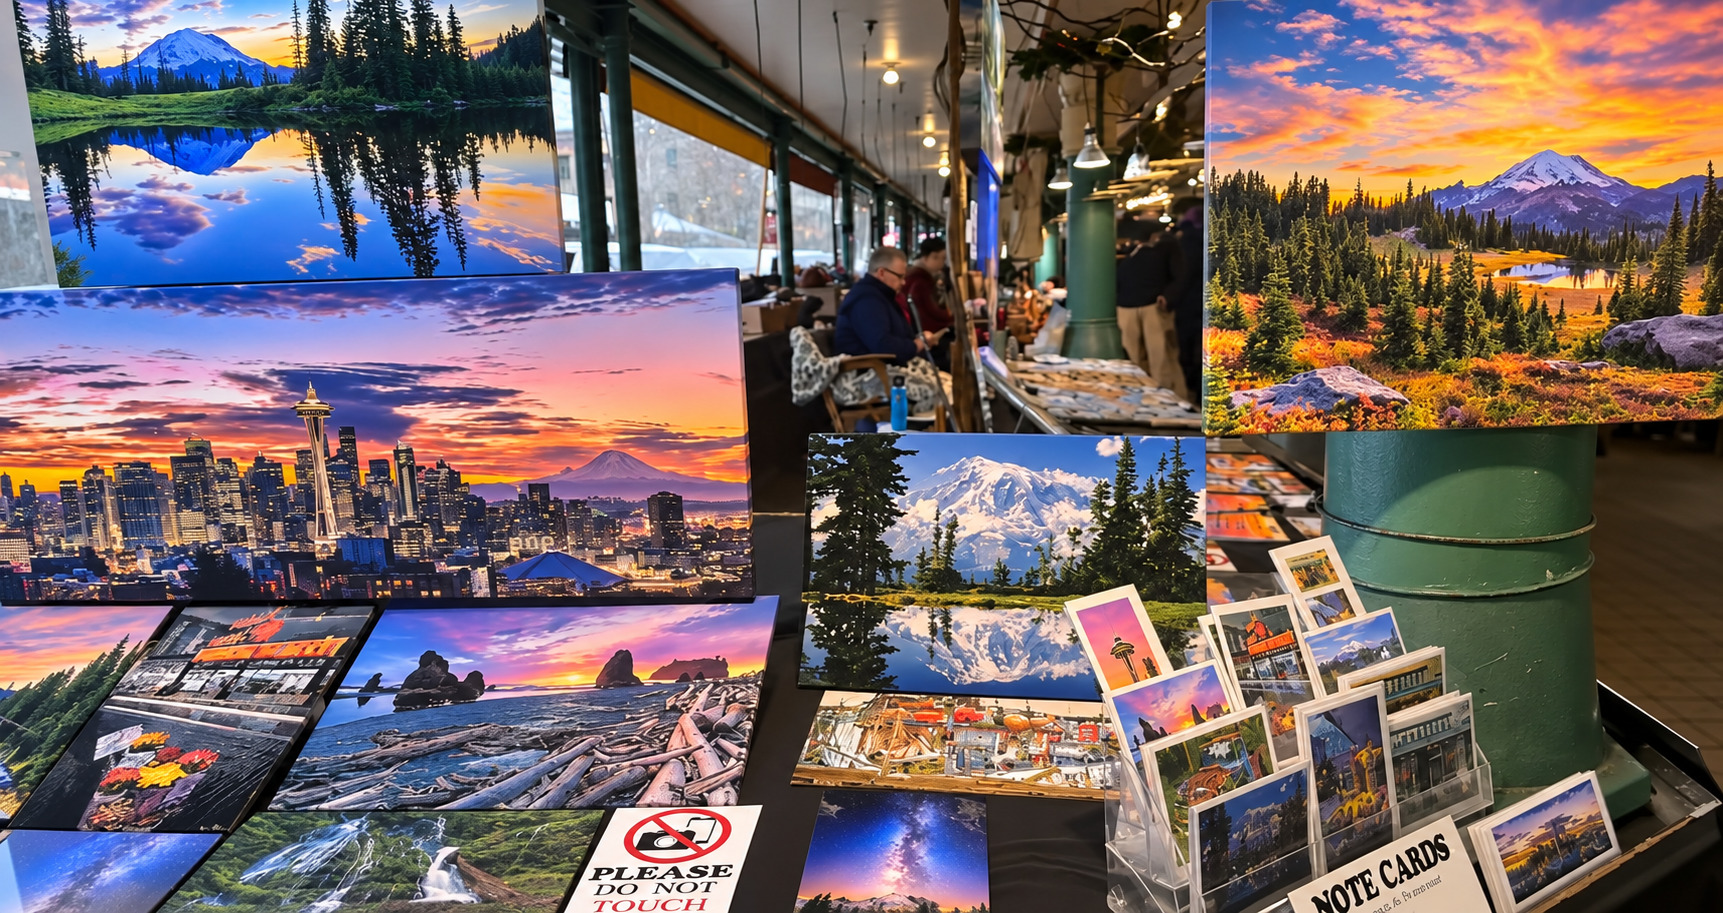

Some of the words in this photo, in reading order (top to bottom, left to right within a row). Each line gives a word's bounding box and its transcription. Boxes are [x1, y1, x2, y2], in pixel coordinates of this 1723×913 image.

[588, 864, 733, 881] PLEASE
[1311, 869, 1379, 913] NOTE
[1379, 833, 1450, 890] CARDS
[594, 883, 639, 896] DO
[652, 881, 718, 894] NOT
[593, 898, 707, 913] TOUCH
